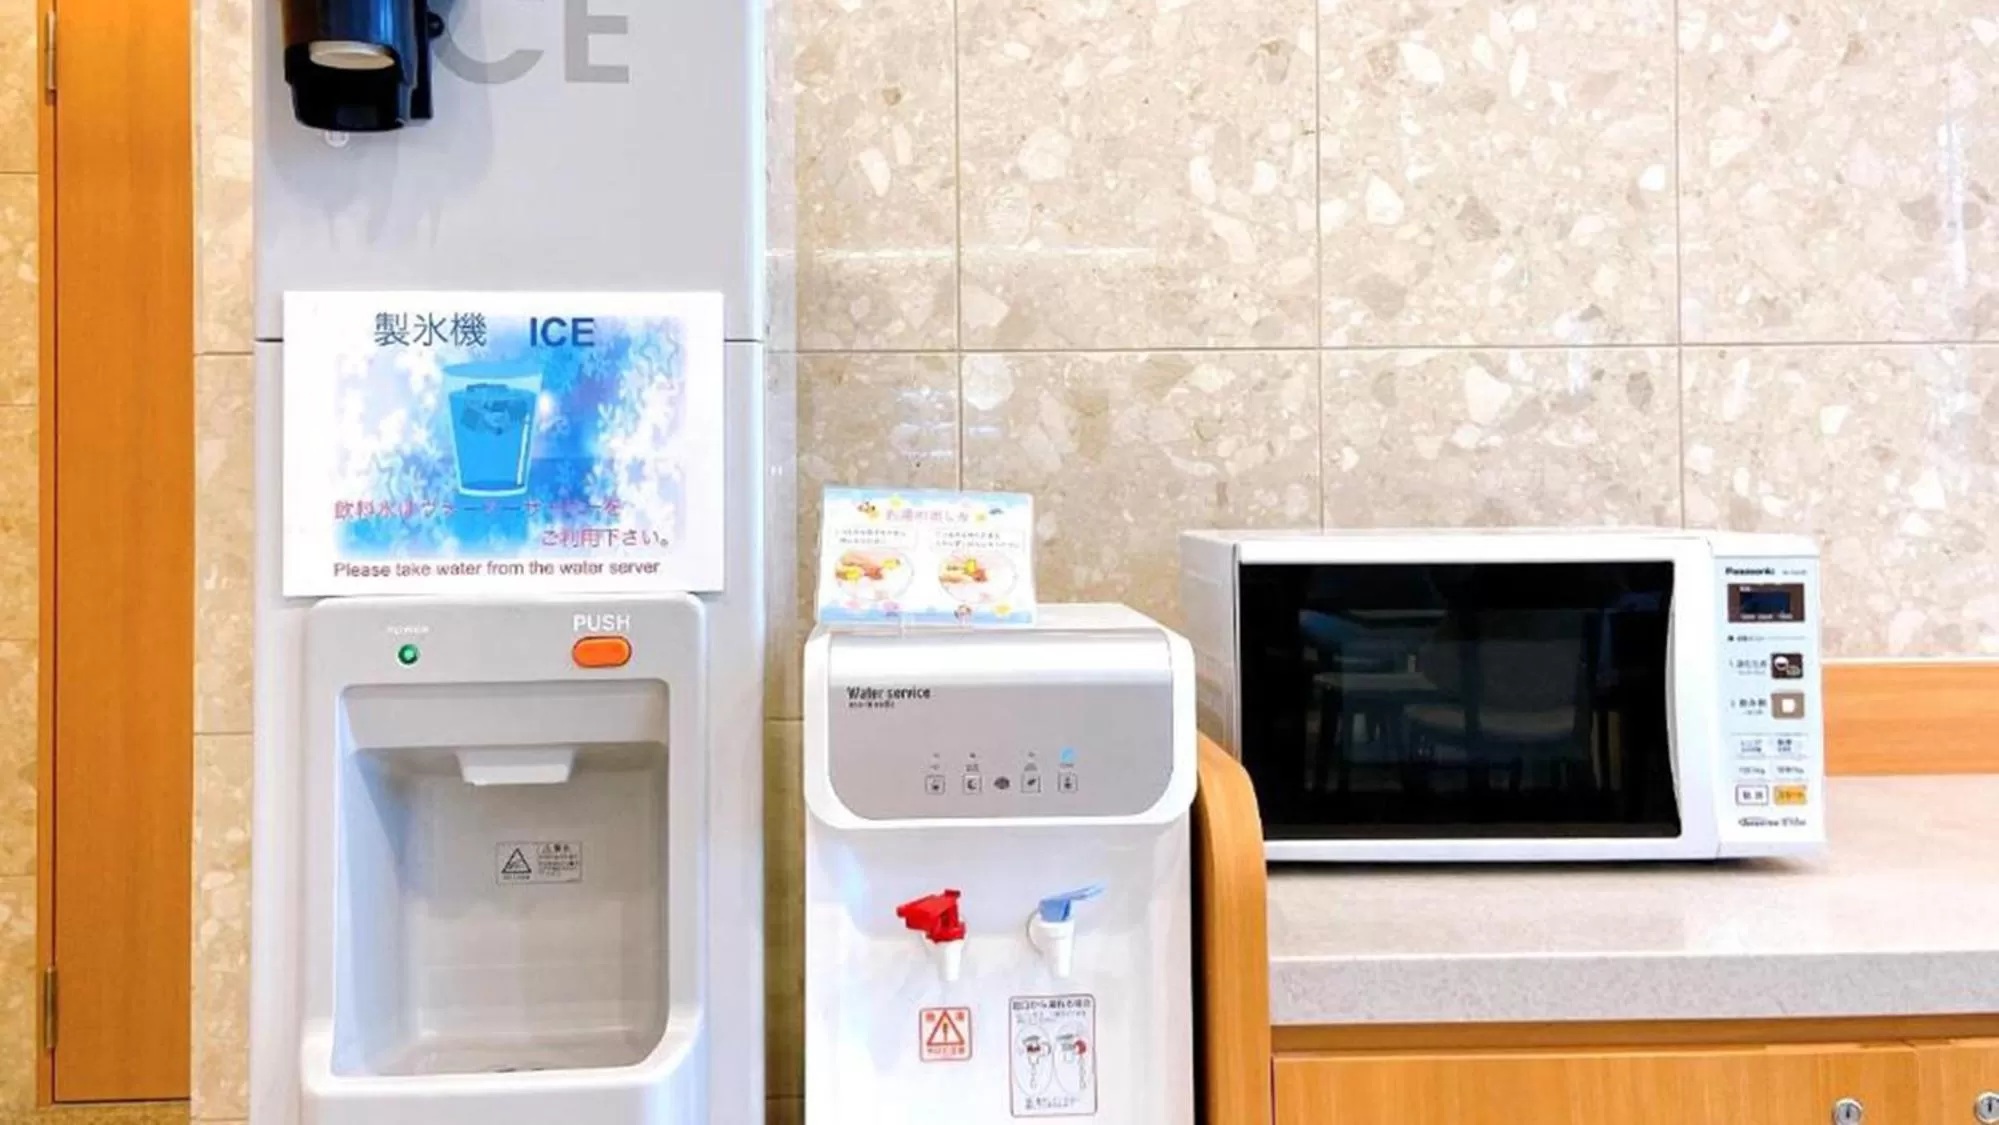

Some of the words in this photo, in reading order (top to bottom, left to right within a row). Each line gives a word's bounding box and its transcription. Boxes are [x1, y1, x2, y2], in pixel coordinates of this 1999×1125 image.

[374, 311, 488, 348] 製氷機
[530, 316, 597, 349] ICE
[333, 562, 392, 578] Please
[395, 561, 432, 578] take
[435, 561, 483, 577] water
[486, 560, 525, 576] from
[528, 560, 555, 576] the
[559, 560, 605, 575] water
[608, 562, 661, 575] server
[573, 614, 630, 631] PUSH
[847, 686, 883, 700] Water
[887, 685, 931, 700] service
